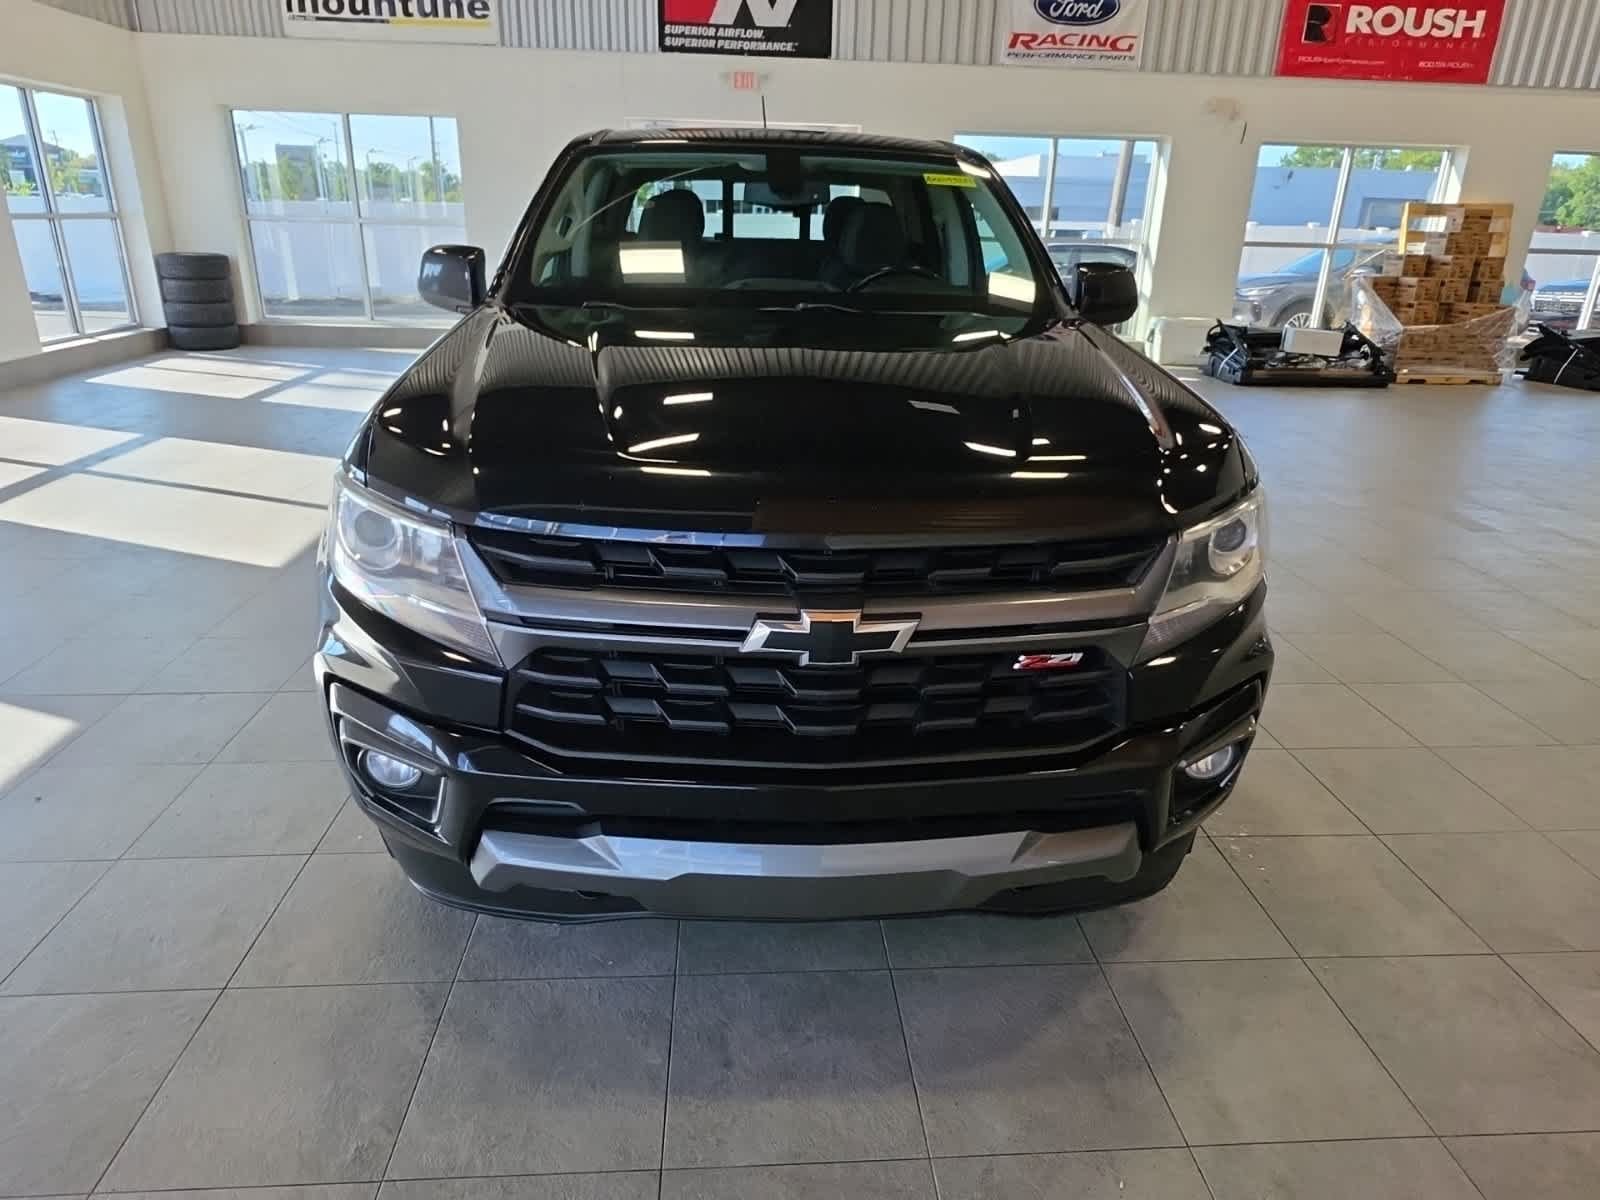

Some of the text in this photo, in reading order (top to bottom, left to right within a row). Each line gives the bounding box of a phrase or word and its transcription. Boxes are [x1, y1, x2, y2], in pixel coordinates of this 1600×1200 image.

[1345, 5, 1487, 38] ROUSH
[664, 25, 766, 39] SUPERIOR AIRFLOW.
[664, 37, 716, 48] SUPERIOR
[1008, 32, 1138, 52] RACING
[1007, 52, 1096, 60] PERFORMANCE
